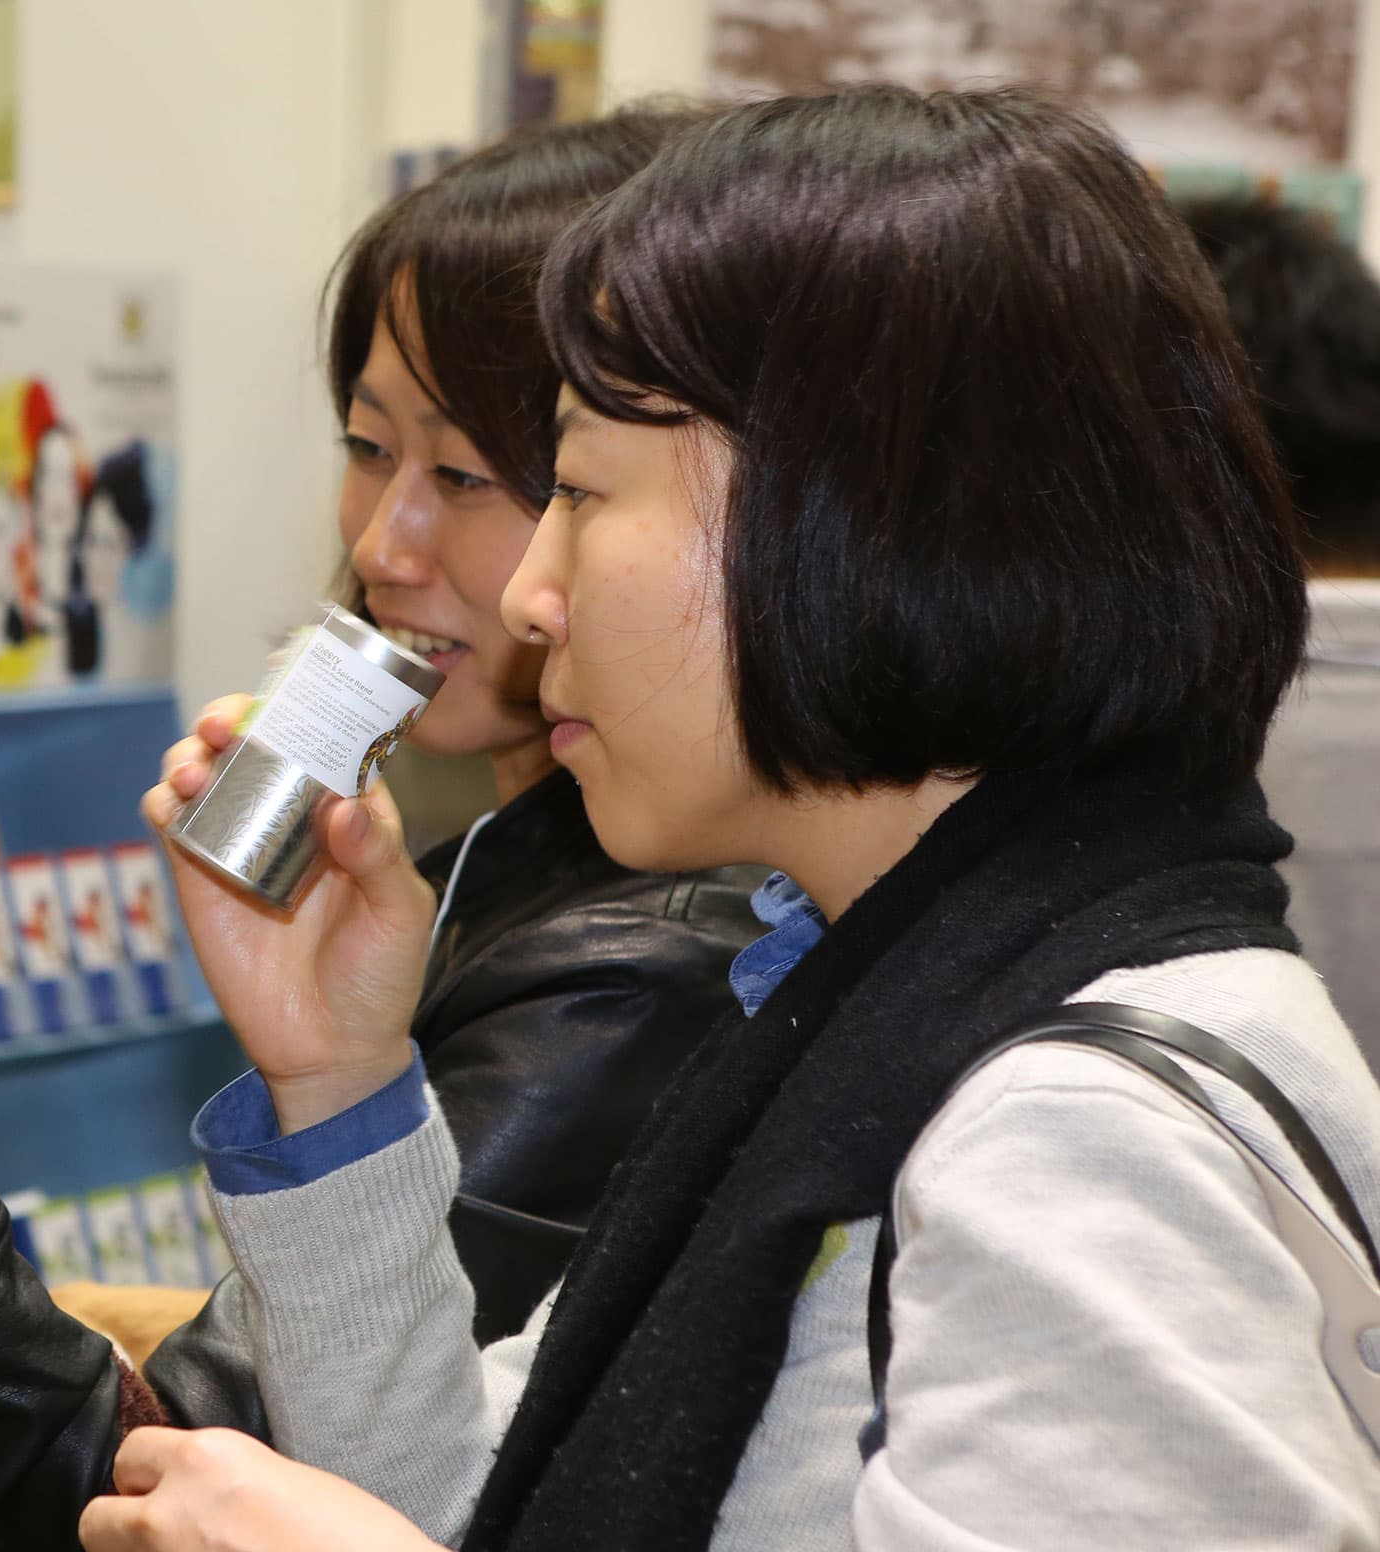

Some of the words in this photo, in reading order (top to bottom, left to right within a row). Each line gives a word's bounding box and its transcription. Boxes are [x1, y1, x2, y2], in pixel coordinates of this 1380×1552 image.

[313, 641, 342, 667] Cheery
[309, 649, 331, 667] Blossom
[335, 668, 355, 684] Spice
[353, 679, 373, 696] Blend
[317, 704, 356, 733] Mediterranean
[342, 713, 357, 725] your
